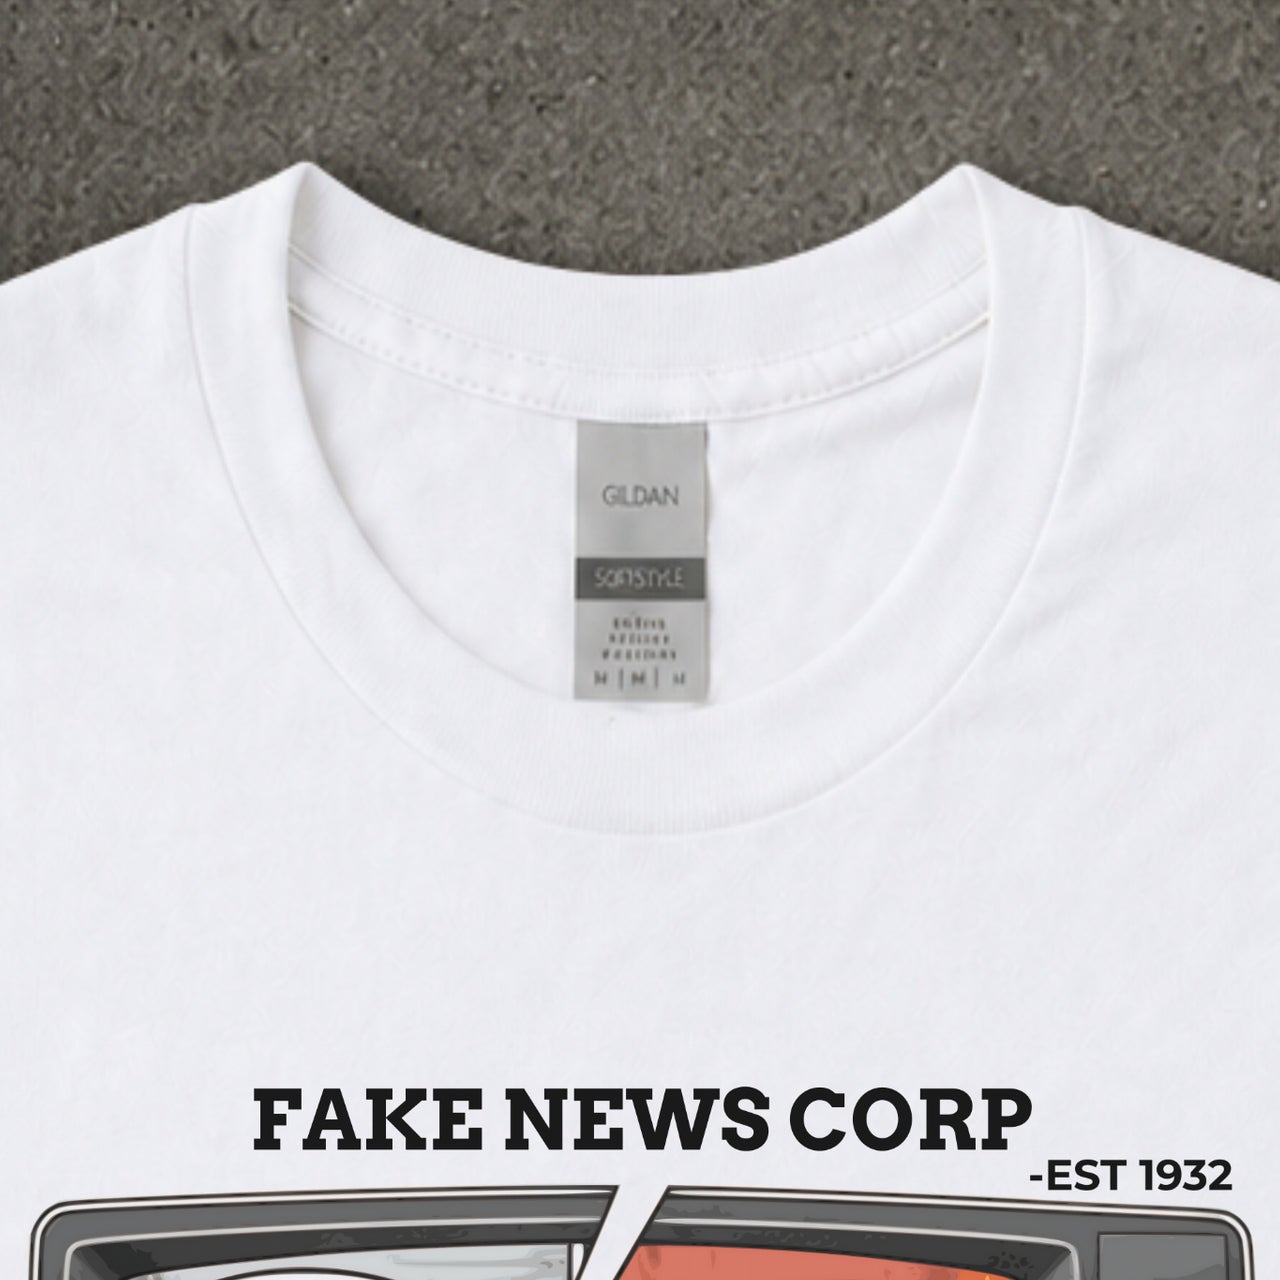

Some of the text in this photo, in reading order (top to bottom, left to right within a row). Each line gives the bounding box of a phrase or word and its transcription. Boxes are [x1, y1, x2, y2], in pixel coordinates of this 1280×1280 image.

[602, 485, 679, 506] GILDAN
[254, 1087, 1032, 1151] FAKE NEWS CORP
[1030, 1160, 1232, 1190] -EST 1932
